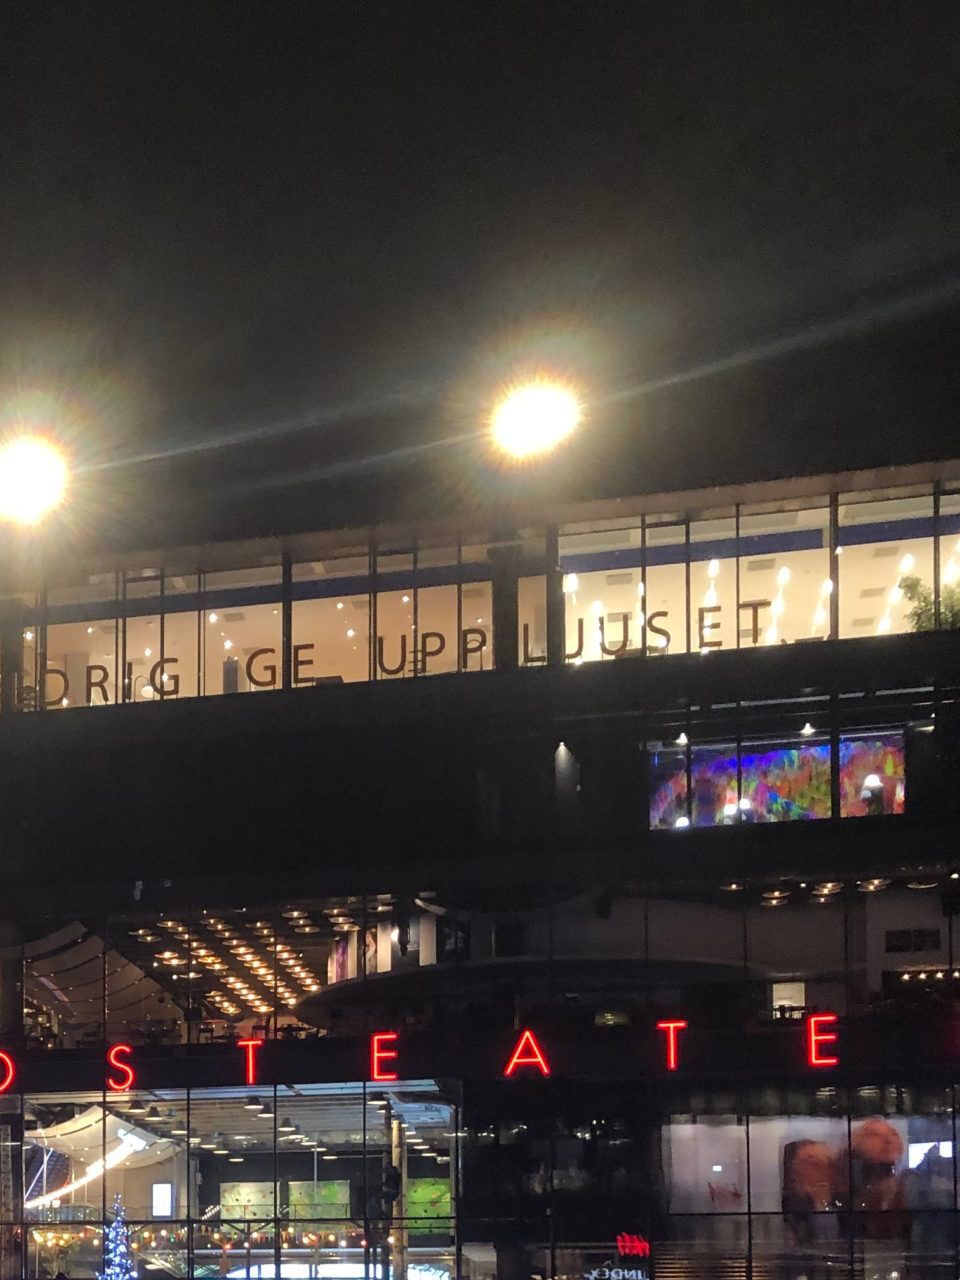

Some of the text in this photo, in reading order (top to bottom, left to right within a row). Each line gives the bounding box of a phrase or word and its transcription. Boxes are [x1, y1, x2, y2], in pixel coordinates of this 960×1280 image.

[246, 643, 315, 688] GE
[377, 628, 488, 677] UPP
[523, 600, 772, 663] LJUSET
